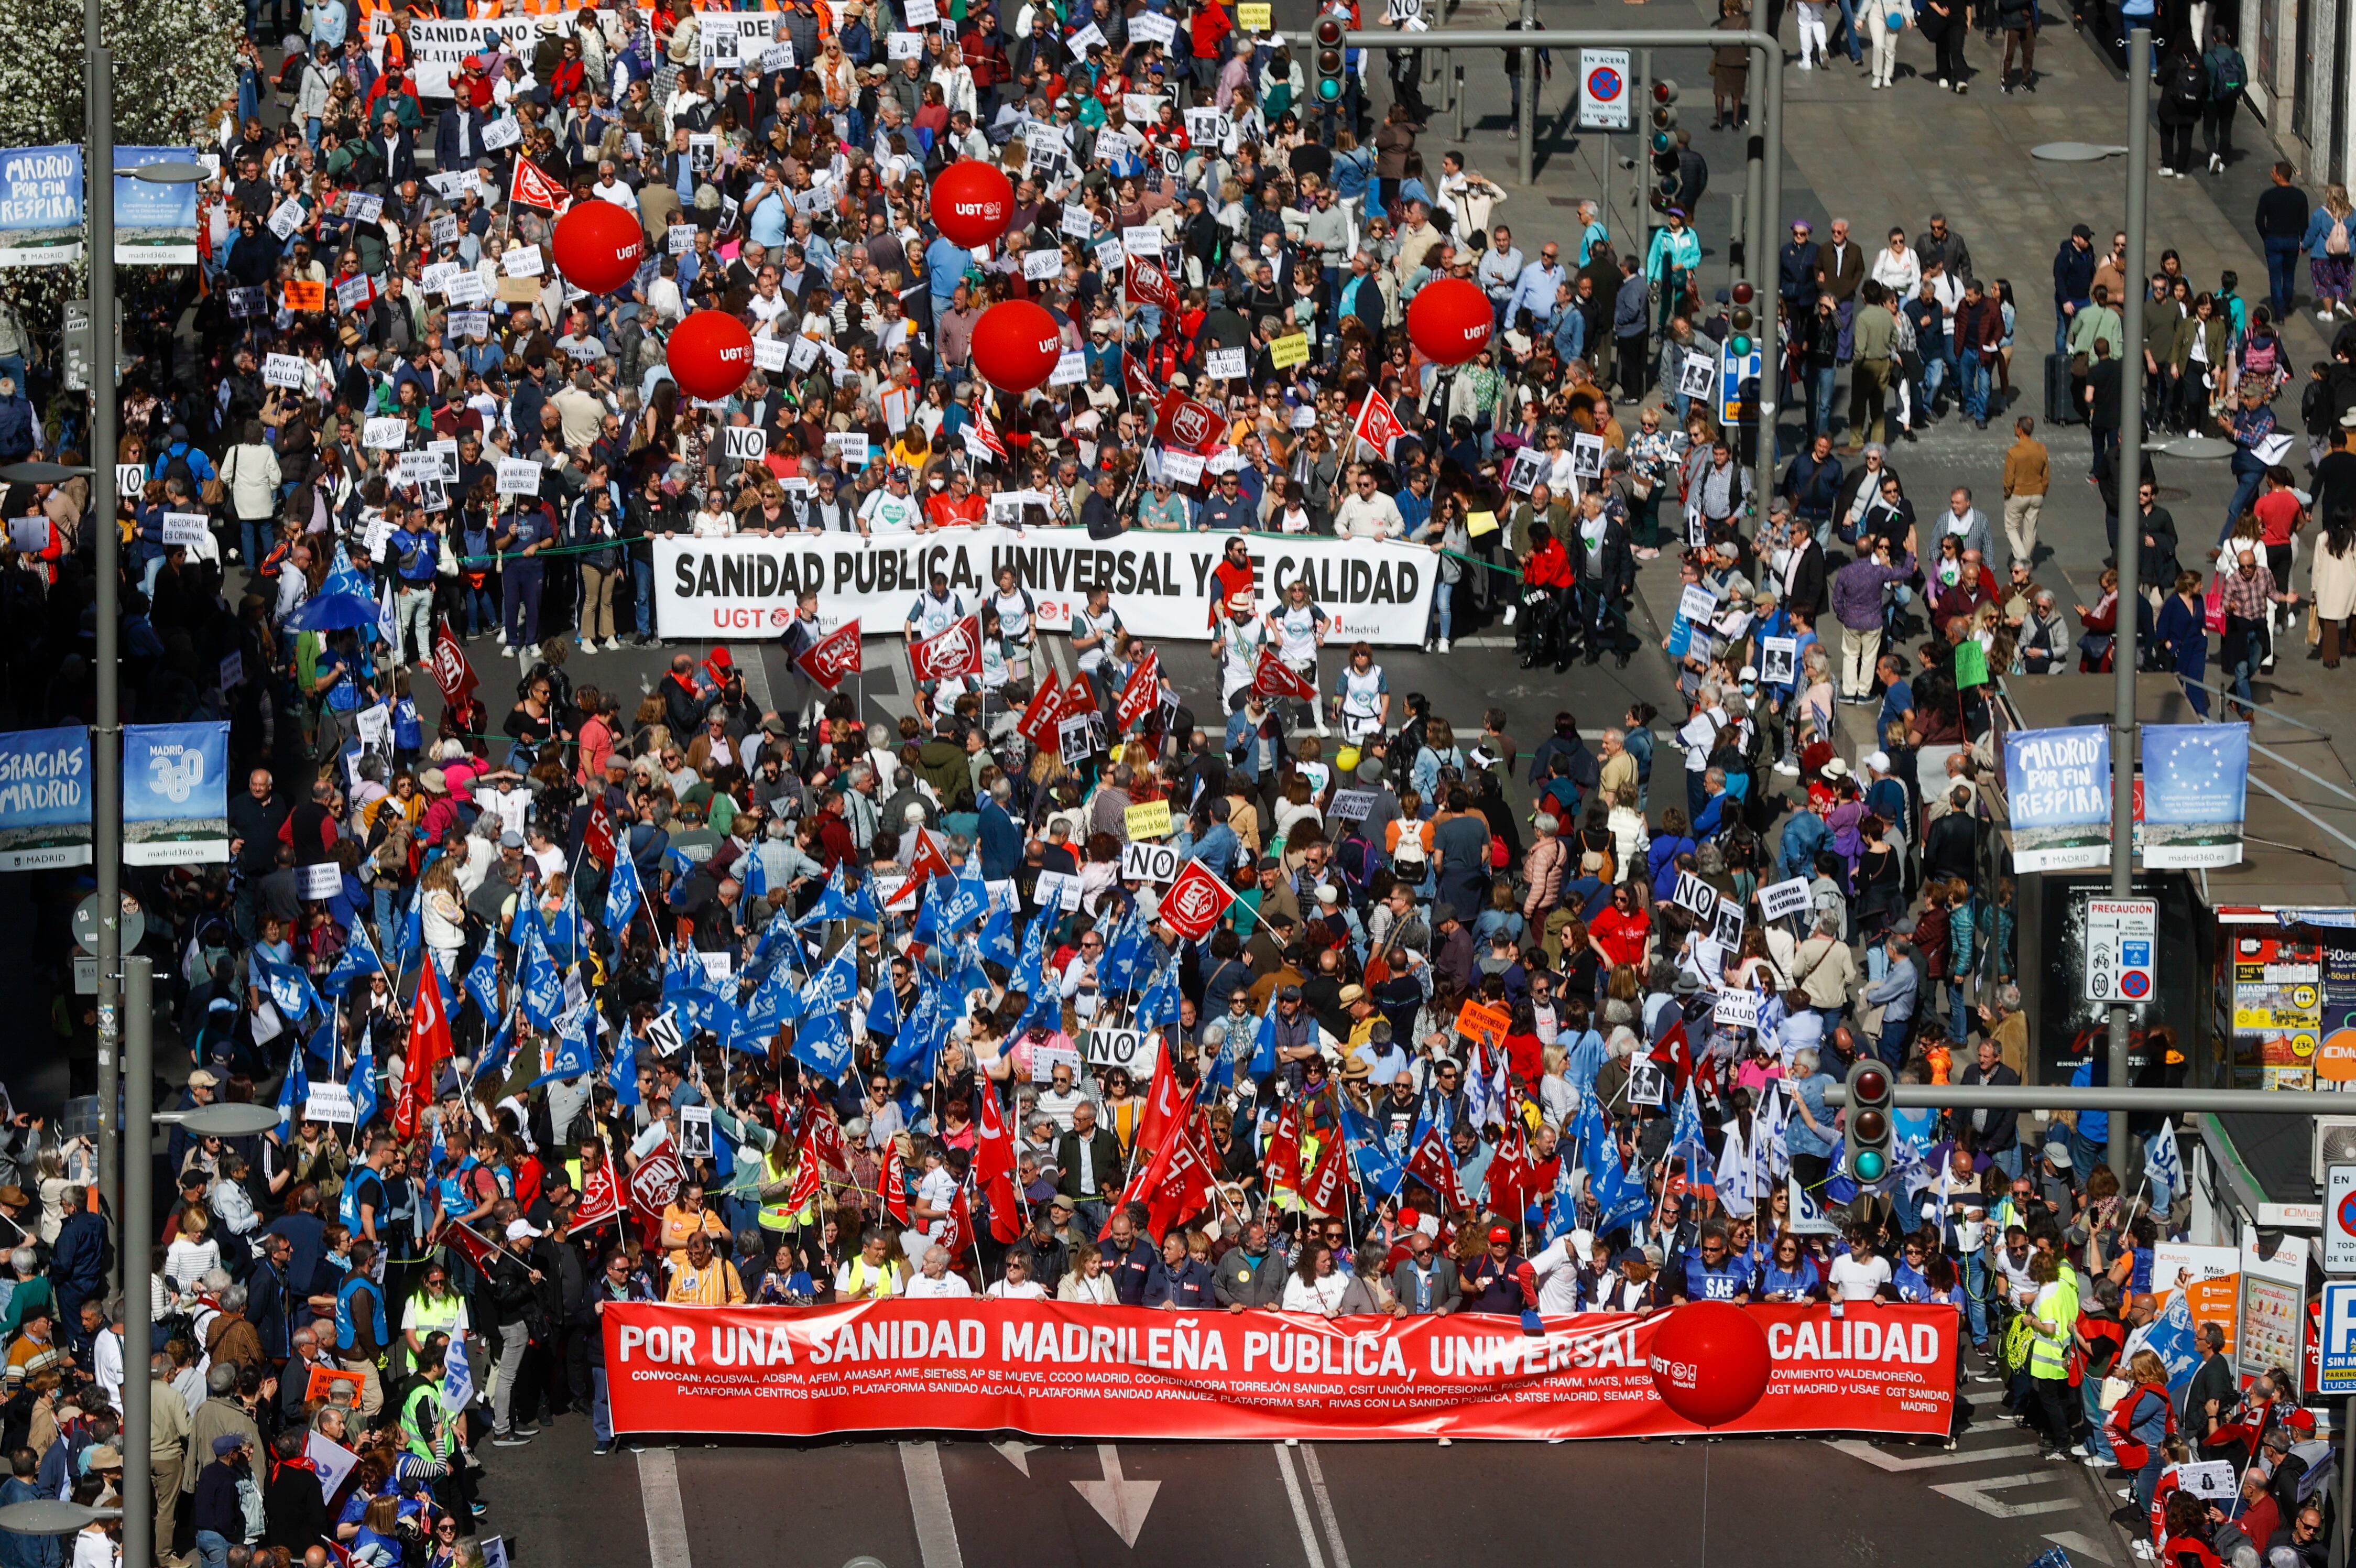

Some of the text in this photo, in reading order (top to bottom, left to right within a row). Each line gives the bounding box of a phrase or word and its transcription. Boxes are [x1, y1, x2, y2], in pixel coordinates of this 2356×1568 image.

[500, 25, 527, 42] NO
[763, 56, 791, 68] SALUD!
[5, 155, 72, 181] MADRID
[12, 180, 66, 199] POR FIN
[2, 200, 77, 222] RESPIRA
[956, 203, 982, 215] UGT
[616, 243, 637, 260] UGT
[230, 301, 267, 314] SALUD!
[1464, 324, 1486, 340] UGT
[1039, 336, 1057, 353] UGT
[720, 347, 743, 361] UGT
[1208, 349, 1242, 361] SE VENDE
[269, 358, 304, 371] ¡Por la
[1180, 406, 1206, 431] UGT
[727, 430, 763, 456] NO
[169, 519, 203, 528] RECORTAR
[174, 531, 203, 541] CRIMINAL
[675, 552, 824, 598] SANIDAD
[993, 546, 1182, 596] UNIVERSAL
[1190, 553, 1213, 596] Y
[1274, 557, 1419, 604] CALIDAD
[714, 608, 765, 628] UGT
[1345, 625, 1379, 634] Madrid
[149, 744, 184, 757] MADRID
[2020, 738, 2099, 769] MADRID
[149, 749, 203, 802] 360
[2027, 767, 2090, 790] POR FIN
[1331, 803, 1367, 815] TU SALUD!
[2016, 787, 2104, 819] RESPIRA
[1128, 820, 1170, 834] Centros de Salud!
[27, 853, 65, 864] MADRID
[148, 848, 203, 858] madrid360.es
[2053, 854, 2089, 864] MADRID
[2168, 853, 2224, 862] madrid360.es
[1129, 846, 1174, 878] NO
[1178, 881, 1208, 914] UGT
[1677, 874, 1712, 914] NO
[1769, 887, 1802, 903] ¡RECUPERA
[1770, 897, 1806, 913] TU SANIDAD!
[2092, 903, 2152, 913] PRECAUCIÓN
[2096, 979, 2106, 990] 30
[2238, 984, 2279, 993] MADRID
[1477, 1012, 1506, 1031] ENFERMERAS
[1092, 1030, 1136, 1063] NO
[583, 1198, 608, 1214] Madrid
[2205, 1266, 2224, 1275] Más
[2250, 1283, 2286, 1300] Granizados
[2253, 1317, 2276, 1330] Helados
[620, 1318, 1938, 1382] POR UNA SANIDAD MADRILEÑA PÚBLICA, UNIVERSAL CALIDAD
[1651, 1353, 1671, 1375] UGT
[2327, 1357, 2346, 1366] SIN
[632, 1369, 1925, 1395] CONVOCAN: ACUSVAL, ADSPM, AFEM, AMASAP, AP SE MUEVE, CCOO MADRID, COORDINADORA TORREJÓN SANIDAD, CSIT FRAVM, MATS, VALDEMOREÑO,
[1673, 1378, 1696, 1389] Madrid
[678, 1381, 1951, 1408] PLATAFORMA CENTROS SALUD, PLATAFORMA SANIDAD ALCALÁ, PLATAFORMA SANIDAD ARANJUEZ, PLATAFORMA RIVAS CON LA PÚBLICA, SATSE MADRID, SEMAP, UGT MADRID y USAE CGT SANIDAD,
[1900, 1400, 1938, 1413] MADRID
[2226, 1462, 2235, 1496] ABUSO
